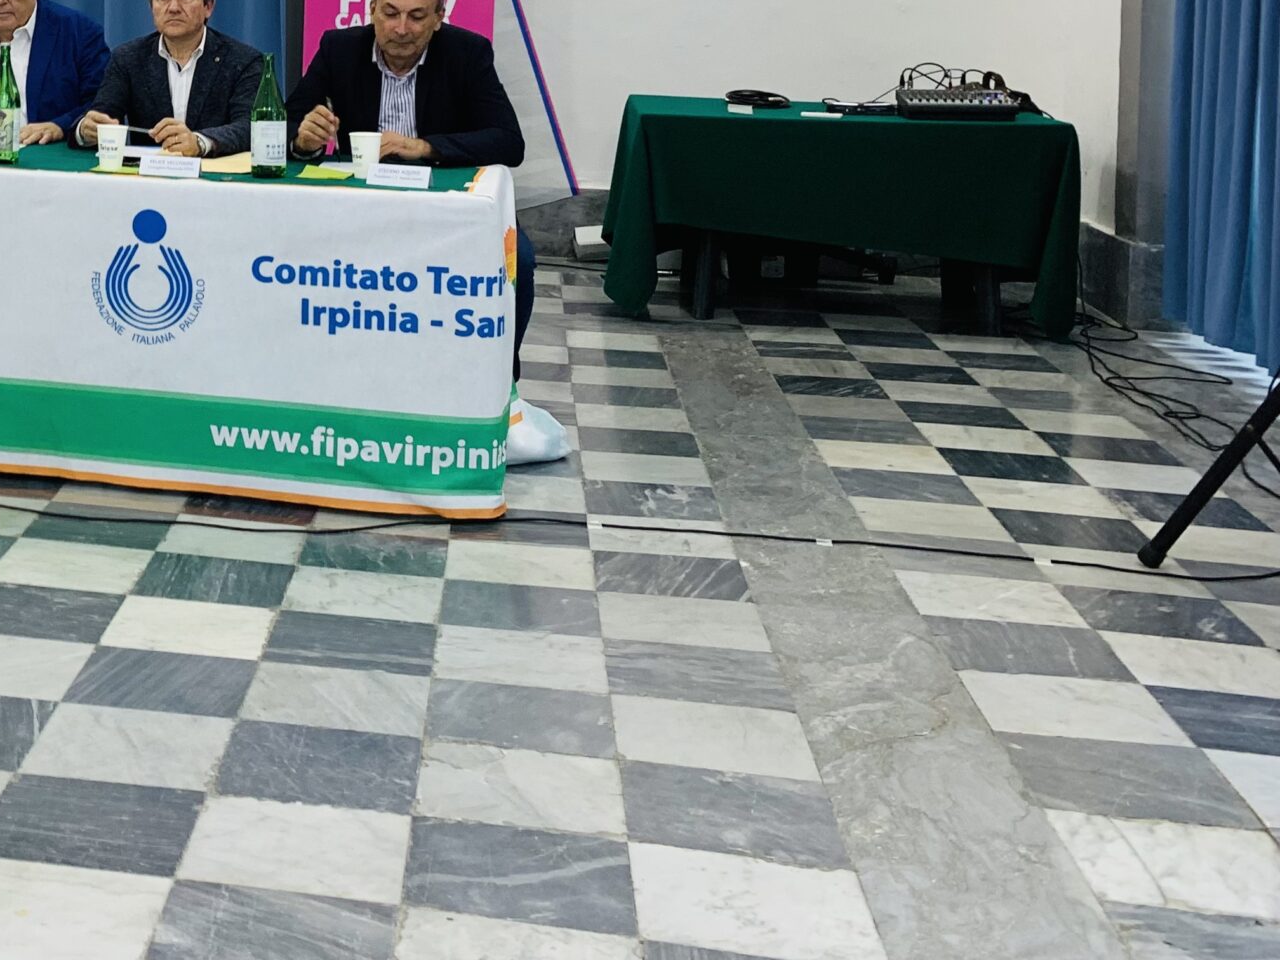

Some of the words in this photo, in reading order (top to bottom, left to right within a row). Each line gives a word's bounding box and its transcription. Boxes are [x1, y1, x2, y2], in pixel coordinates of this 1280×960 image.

[251, 255, 418, 293] Comitato
[91, 270, 126, 336] FEDERAZIONE
[131, 332, 176, 345] ITALIANA
[178, 278, 206, 332] PALLAVOLO
[300, 298, 419, 335] Irpinia
